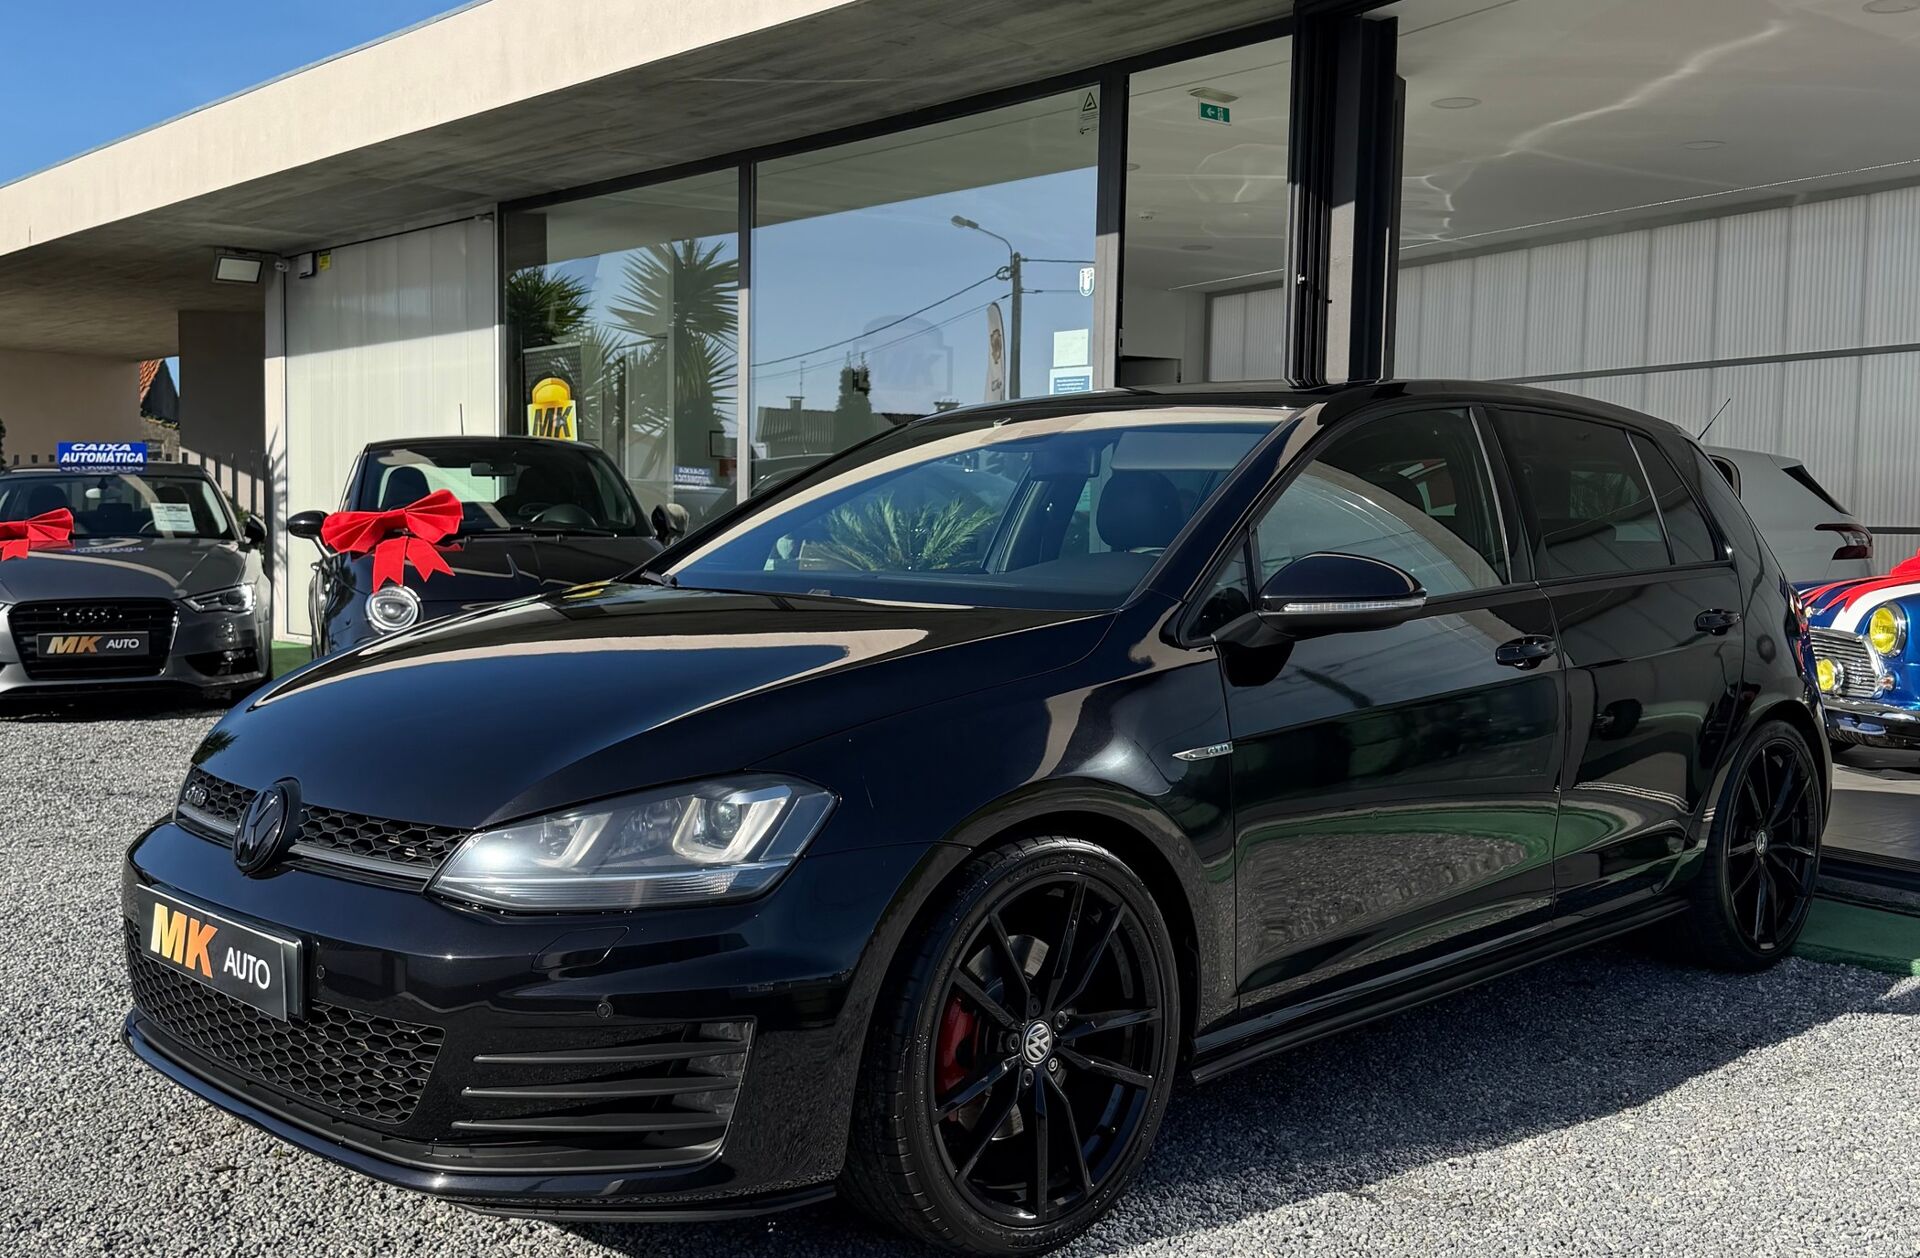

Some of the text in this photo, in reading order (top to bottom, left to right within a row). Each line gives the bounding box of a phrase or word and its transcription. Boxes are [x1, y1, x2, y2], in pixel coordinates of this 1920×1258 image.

[532, 405, 573, 437] MK
[71, 443, 131, 451] CAIXA
[61, 451, 144, 463] AUTOMÁTICA
[46, 635, 140, 654] MK AUTO
[150, 902, 271, 990] MK AUTO
